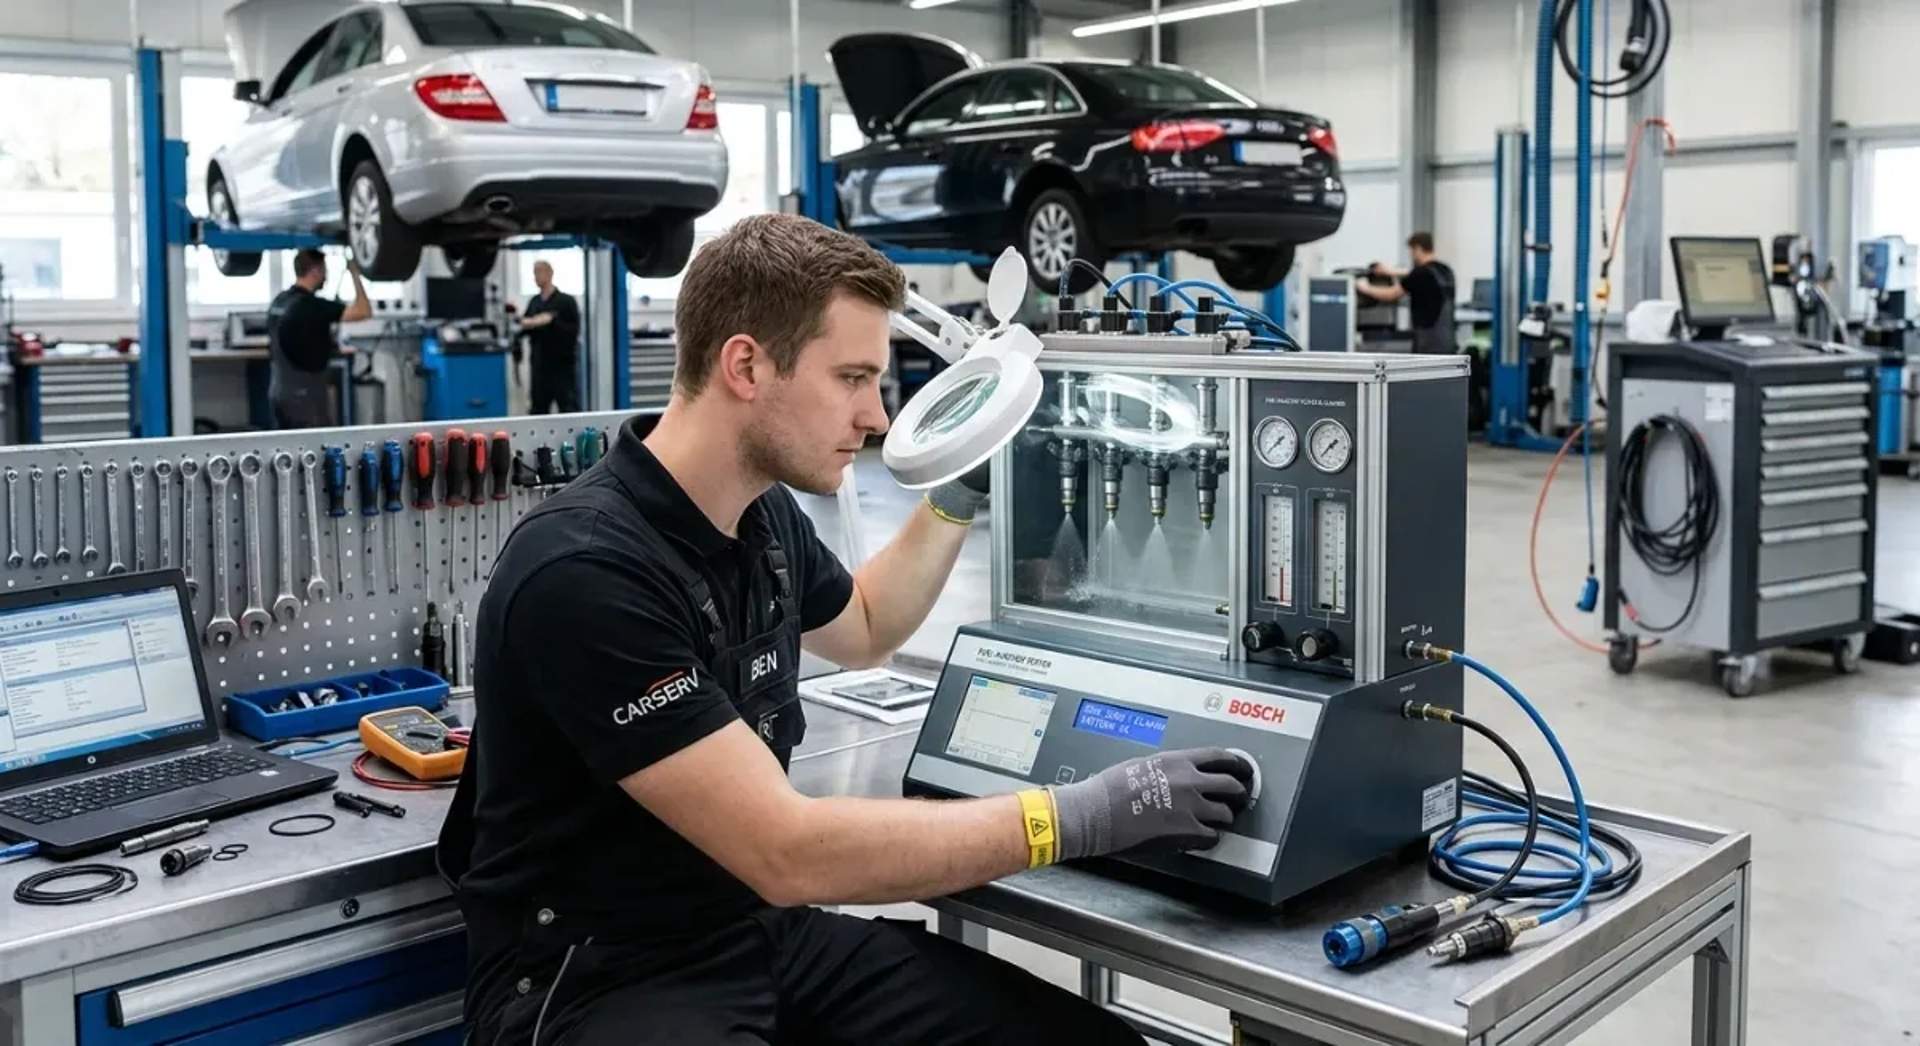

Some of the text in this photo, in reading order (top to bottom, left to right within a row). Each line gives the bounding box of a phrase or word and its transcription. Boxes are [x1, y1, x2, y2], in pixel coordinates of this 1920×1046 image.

[751, 650, 778, 681] BEN
[612, 667, 700, 725] CARSERV
[1228, 699, 1286, 723] BOSCH
